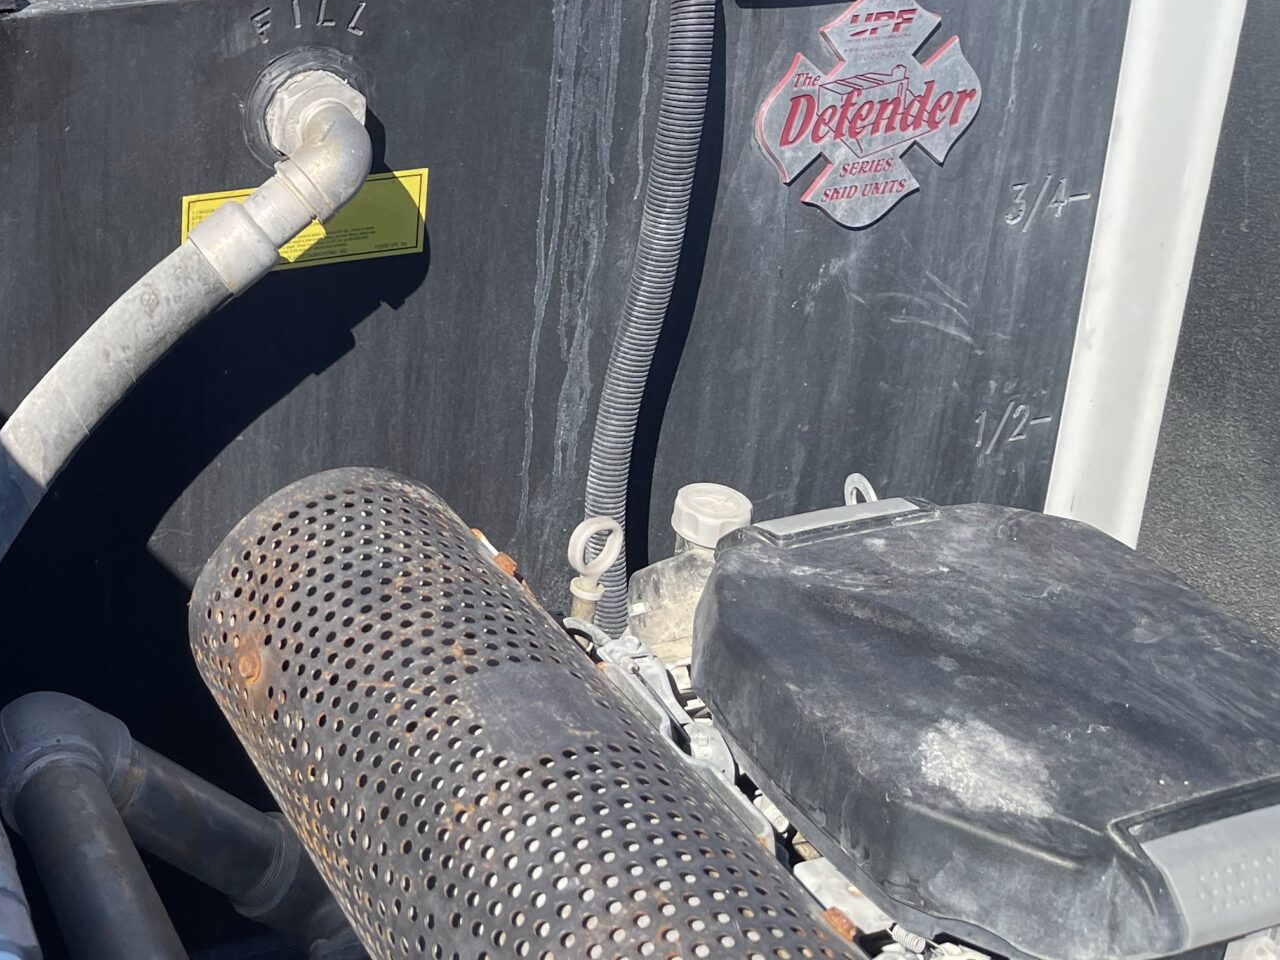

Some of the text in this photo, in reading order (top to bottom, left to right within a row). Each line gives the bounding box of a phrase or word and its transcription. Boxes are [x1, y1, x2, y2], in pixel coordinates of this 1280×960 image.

[849, 8, 919, 38] UPF
[792, 72, 821, 89] The
[778, 79, 977, 149] Defender
[838, 156, 895, 178] SERIES
[820, 178, 908, 203] SKID UNITS
